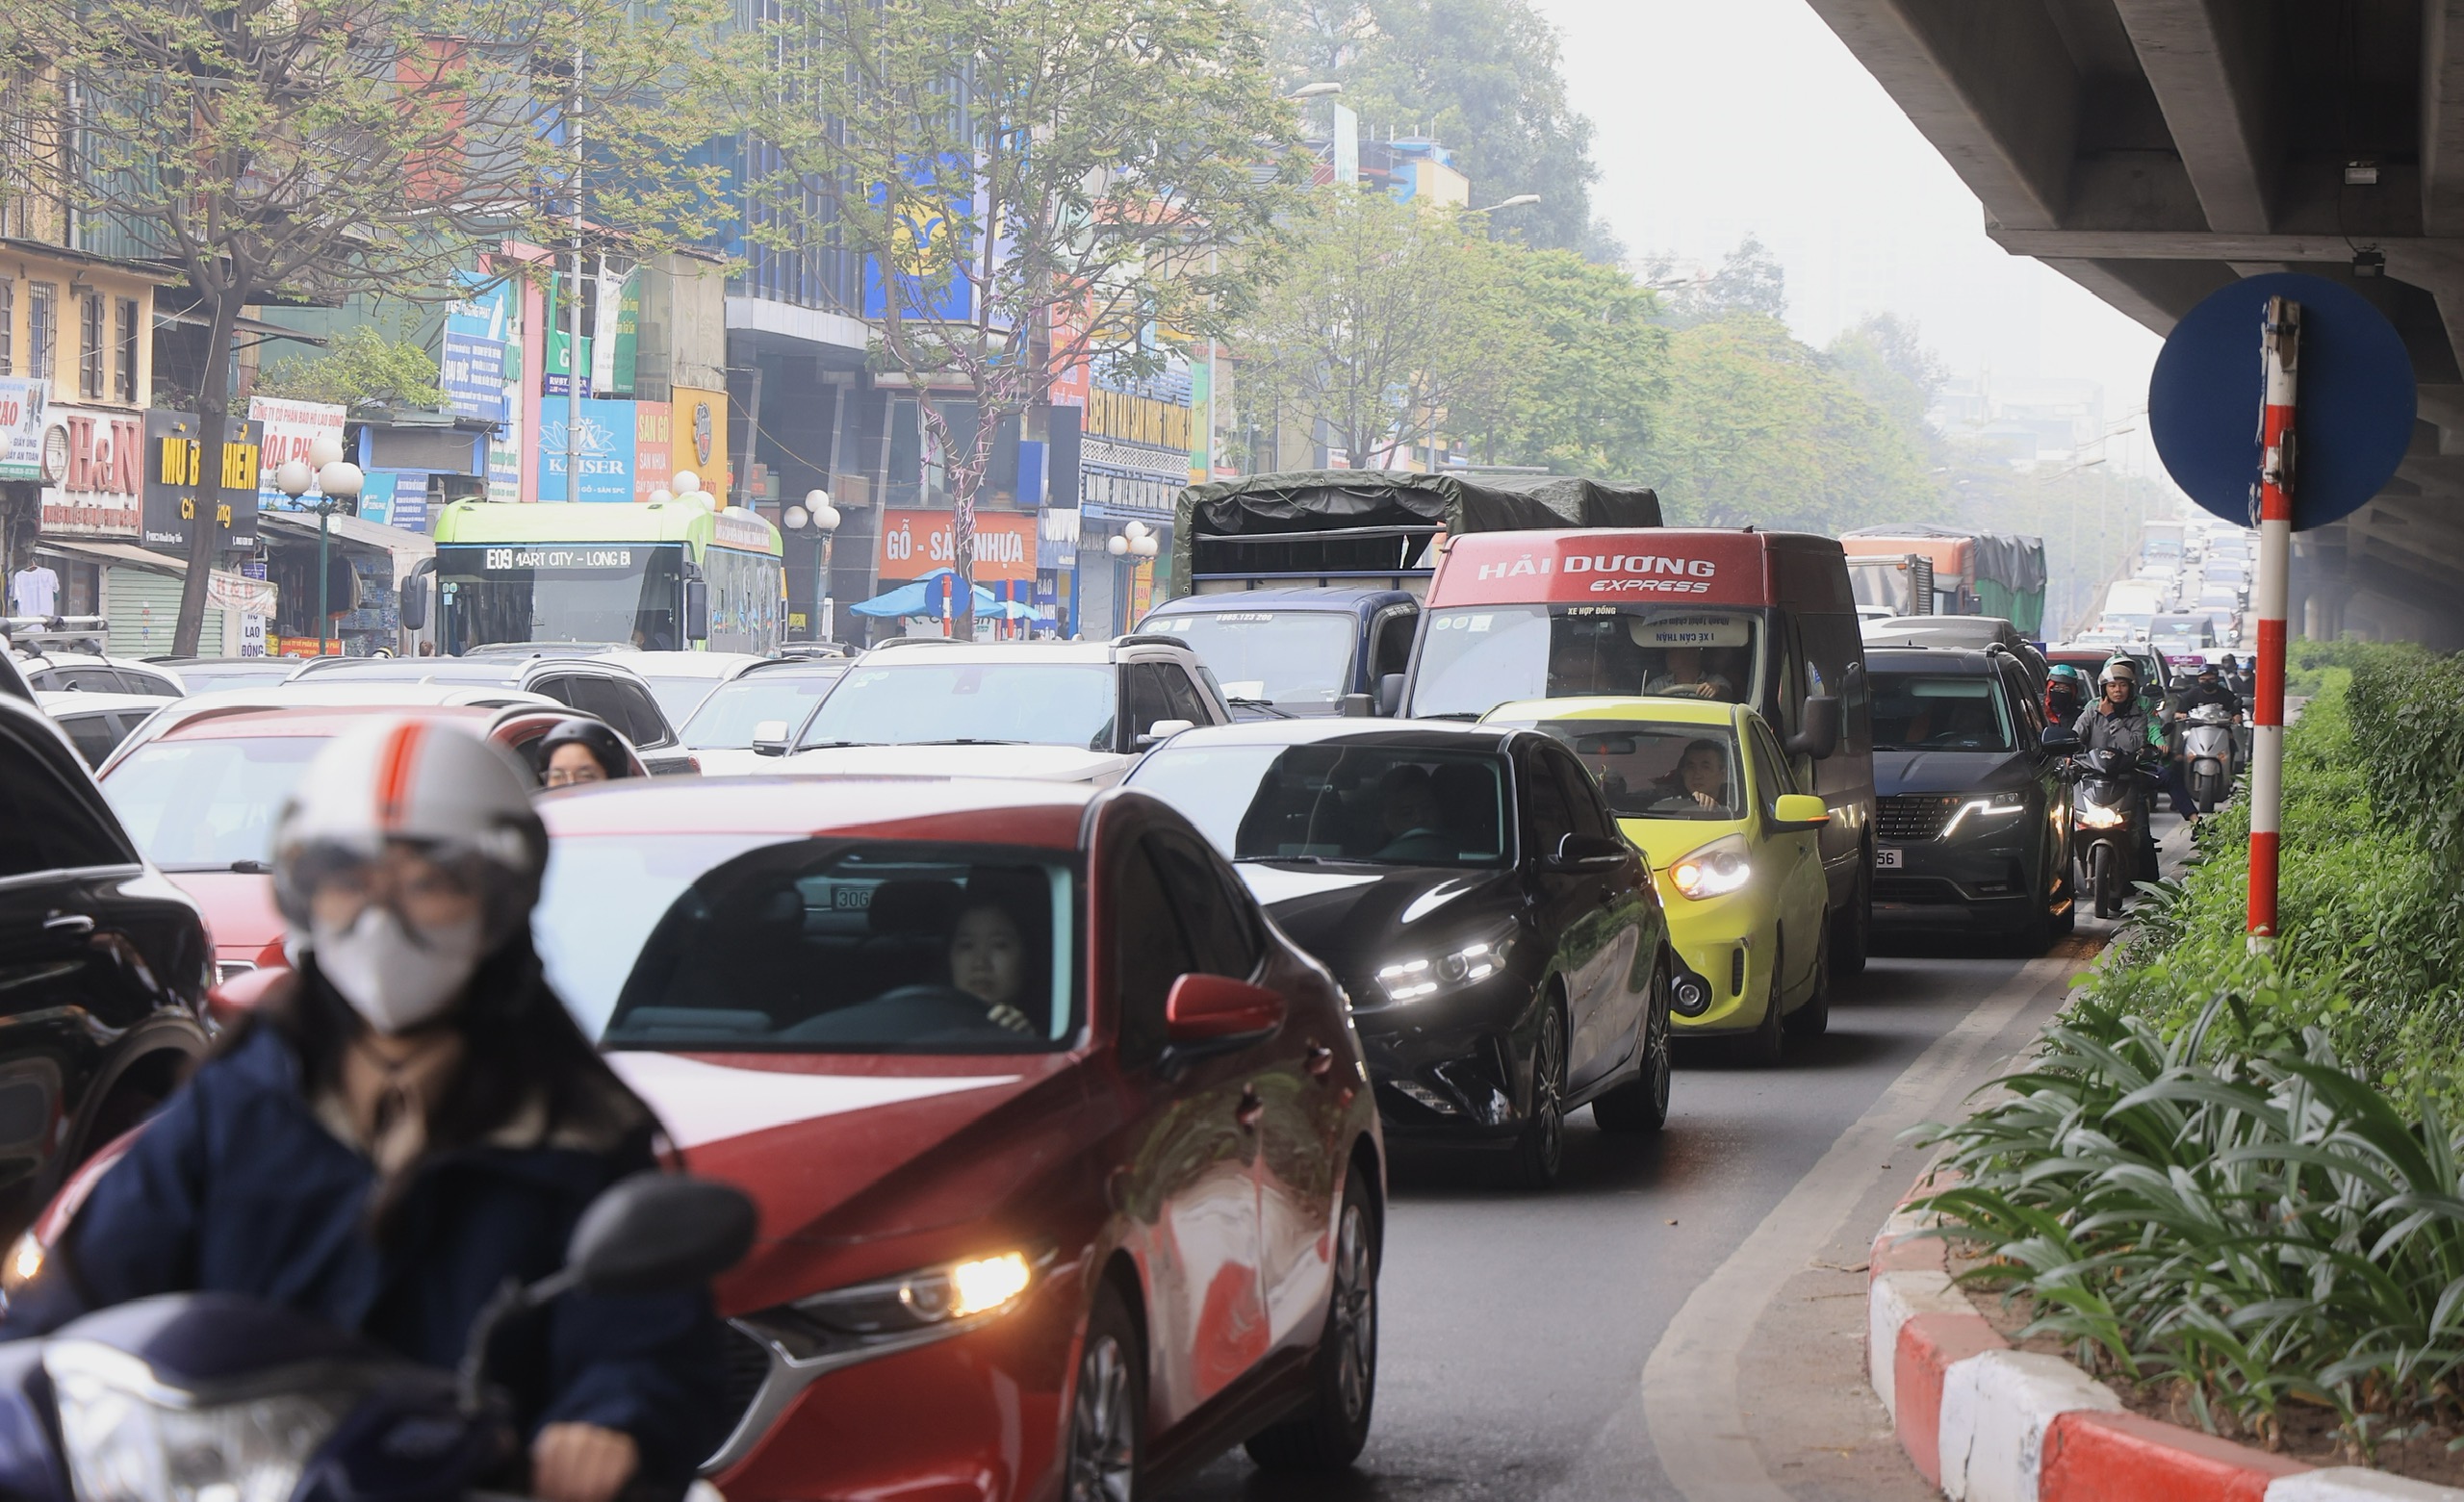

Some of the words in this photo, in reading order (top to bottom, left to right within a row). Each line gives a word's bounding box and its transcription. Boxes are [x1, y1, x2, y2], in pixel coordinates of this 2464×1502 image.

[886, 519, 912, 562] GỖ
[929, 524, 956, 561] SÀ
[973, 530, 1024, 569] NHỰA
[486, 548, 513, 570] E09
[549, 551, 574, 566] CITY
[586, 551, 618, 566] LONG
[1477, 553, 1552, 581] HẢI
[1563, 554, 1716, 577] DƯƠNG
[1037, 572, 1053, 596] BẢO
[1589, 579, 1711, 594] EXPRESS
[1567, 607, 1578, 616] XE
[1578, 606, 1595, 618] HỢP
[1595, 604, 1616, 616] ĐỒNG
[244, 626, 261, 638] LAO
[838, 891, 869, 907] 30G
